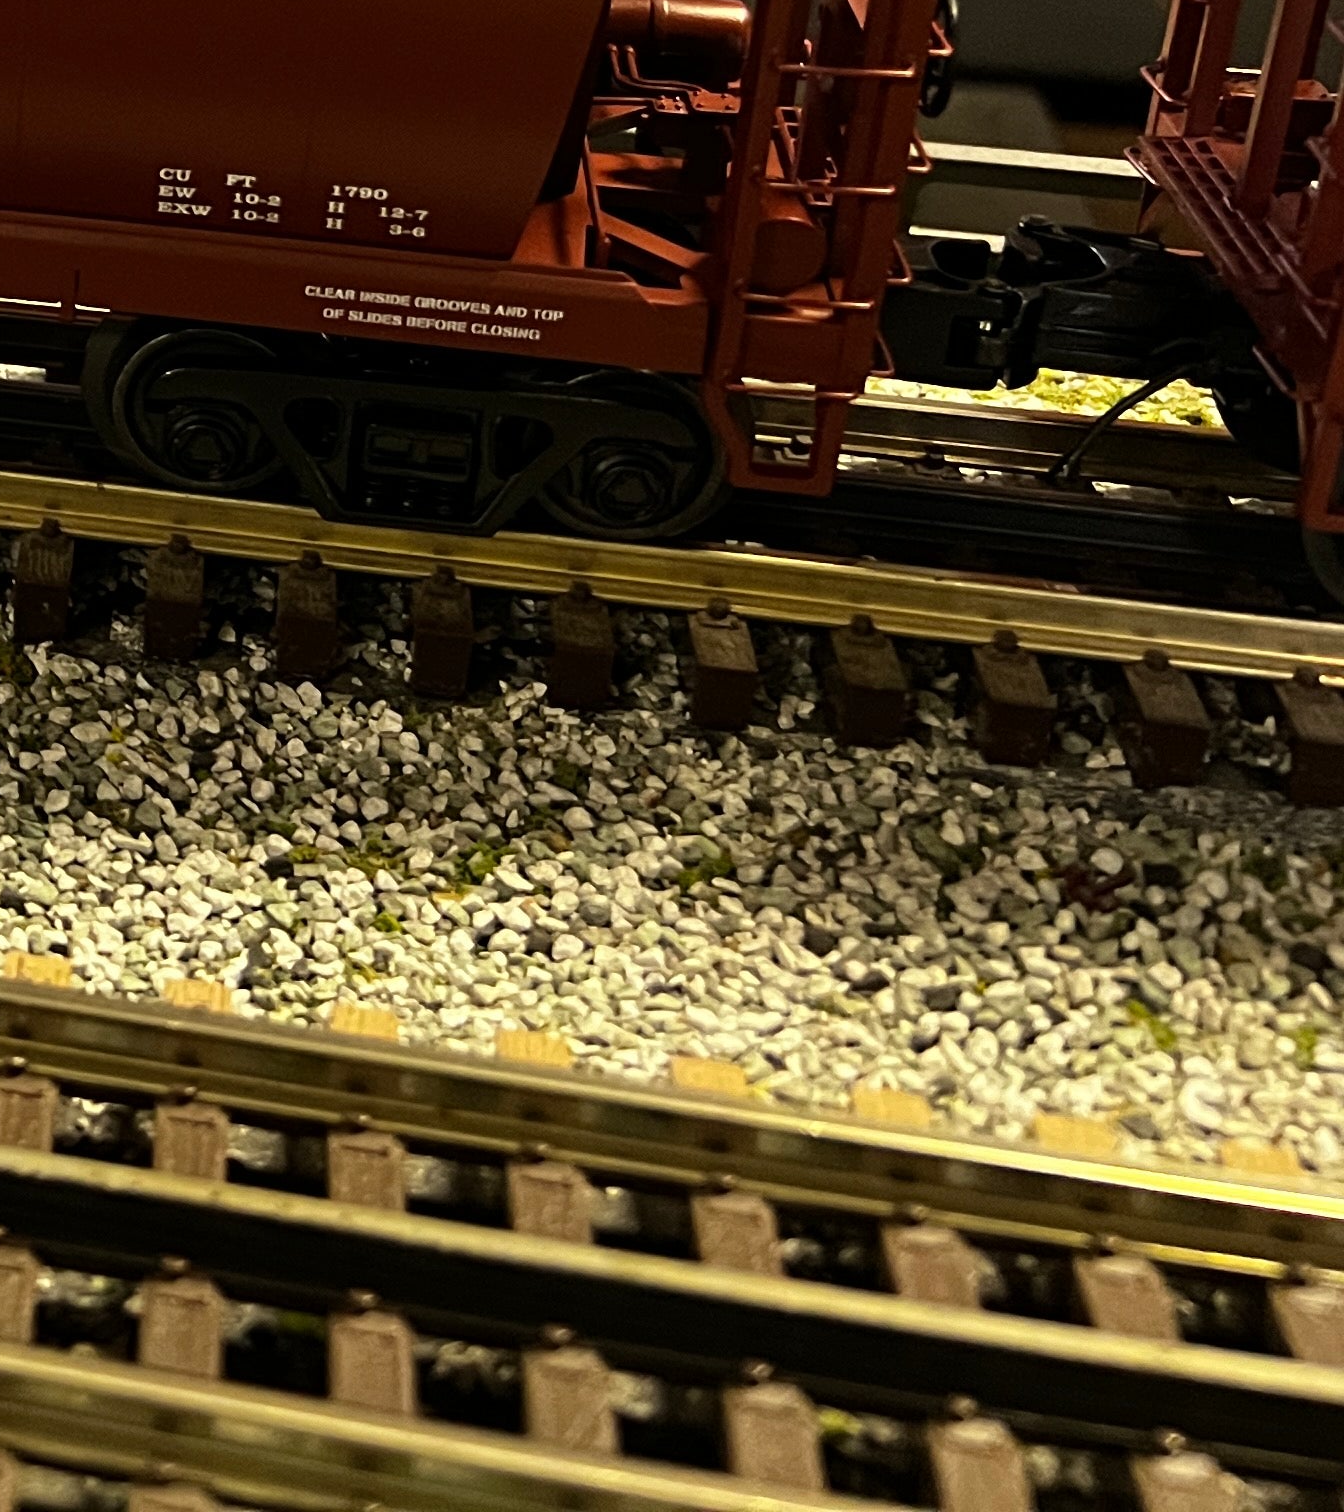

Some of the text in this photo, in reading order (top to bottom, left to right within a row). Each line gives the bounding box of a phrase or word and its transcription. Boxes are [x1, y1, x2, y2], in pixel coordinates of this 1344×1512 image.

[159, 168, 389, 200] CU FT 1790
[158, 185, 429, 221] EW 10-2 H 12-7
[158, 201, 426, 238] EXW 10-2 H 3-6
[305, 285, 564, 322] CLEAR INSIDE GROOVES AND TOP
[323, 307, 541, 341] OF SLIDES BEFORE CLOSING
